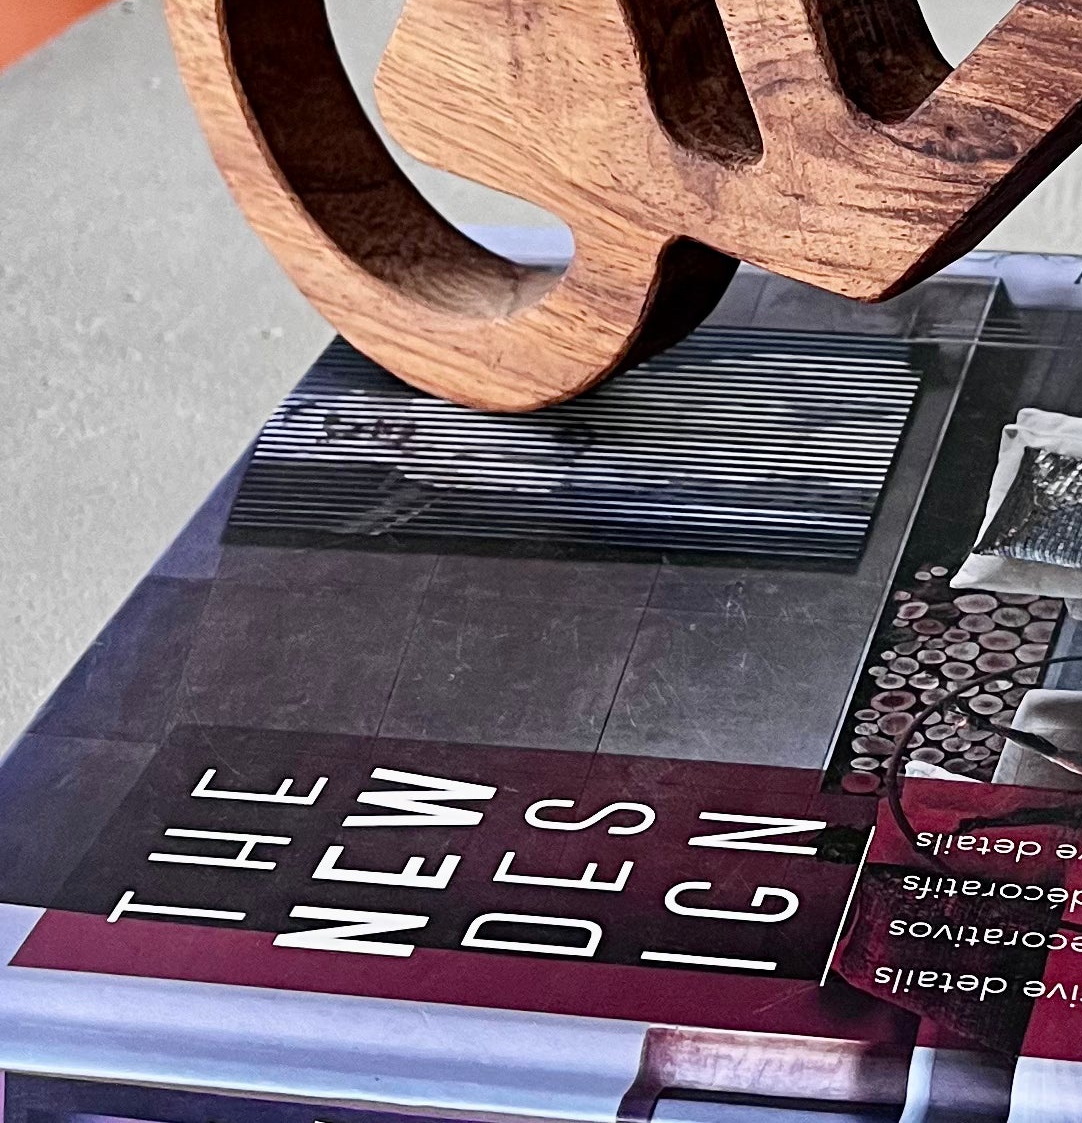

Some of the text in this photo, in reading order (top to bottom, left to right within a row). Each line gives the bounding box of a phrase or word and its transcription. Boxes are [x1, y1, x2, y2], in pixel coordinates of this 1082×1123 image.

[107, 768, 329, 922] THE
[272, 767, 497, 957] NEW
[460, 799, 656, 957] DES
[640, 812, 827, 971] IGN
[916, 831, 1042, 863] details
[874, 965, 1008, 1002] details
